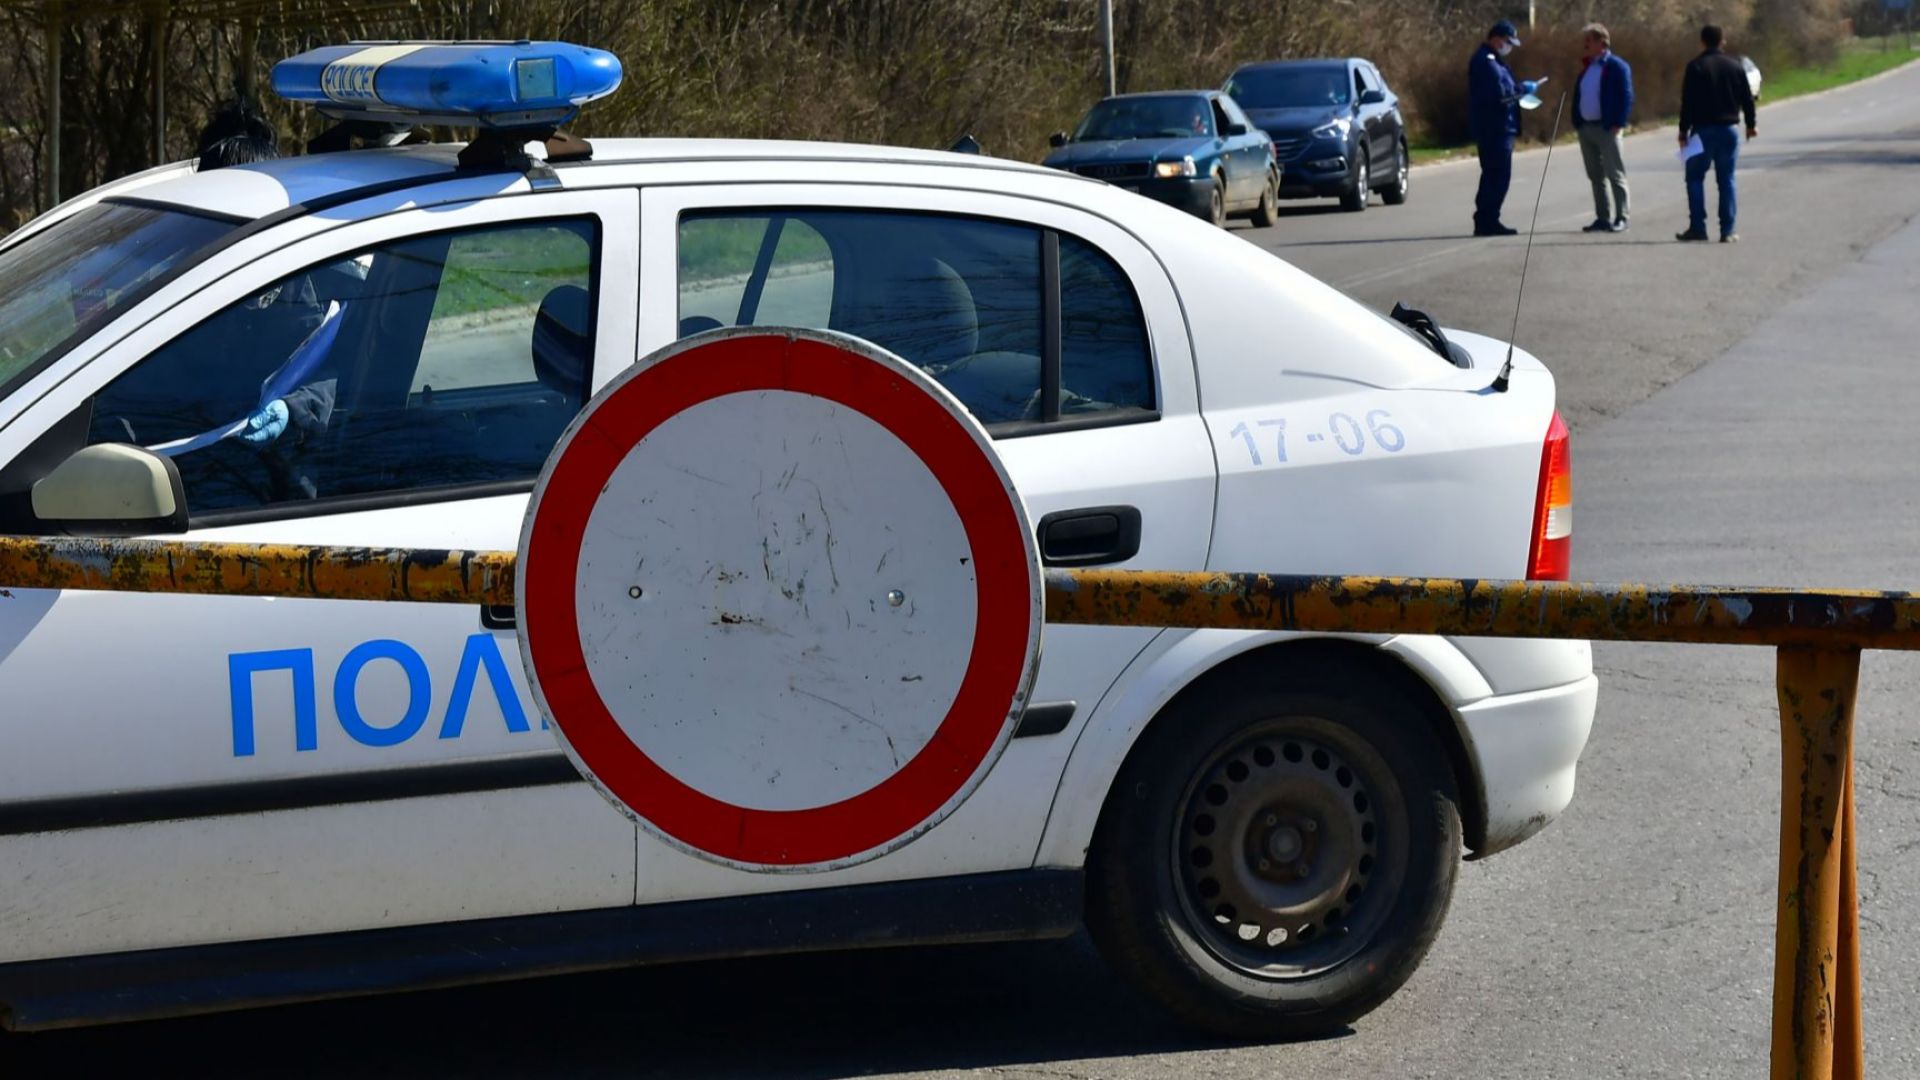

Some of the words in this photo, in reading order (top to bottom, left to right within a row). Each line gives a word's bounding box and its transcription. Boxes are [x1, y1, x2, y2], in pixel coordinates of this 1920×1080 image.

[325, 64, 375, 97] POLICE
[1230, 409, 1405, 466] 17-06
[228, 632, 548, 757] ПОЛ
